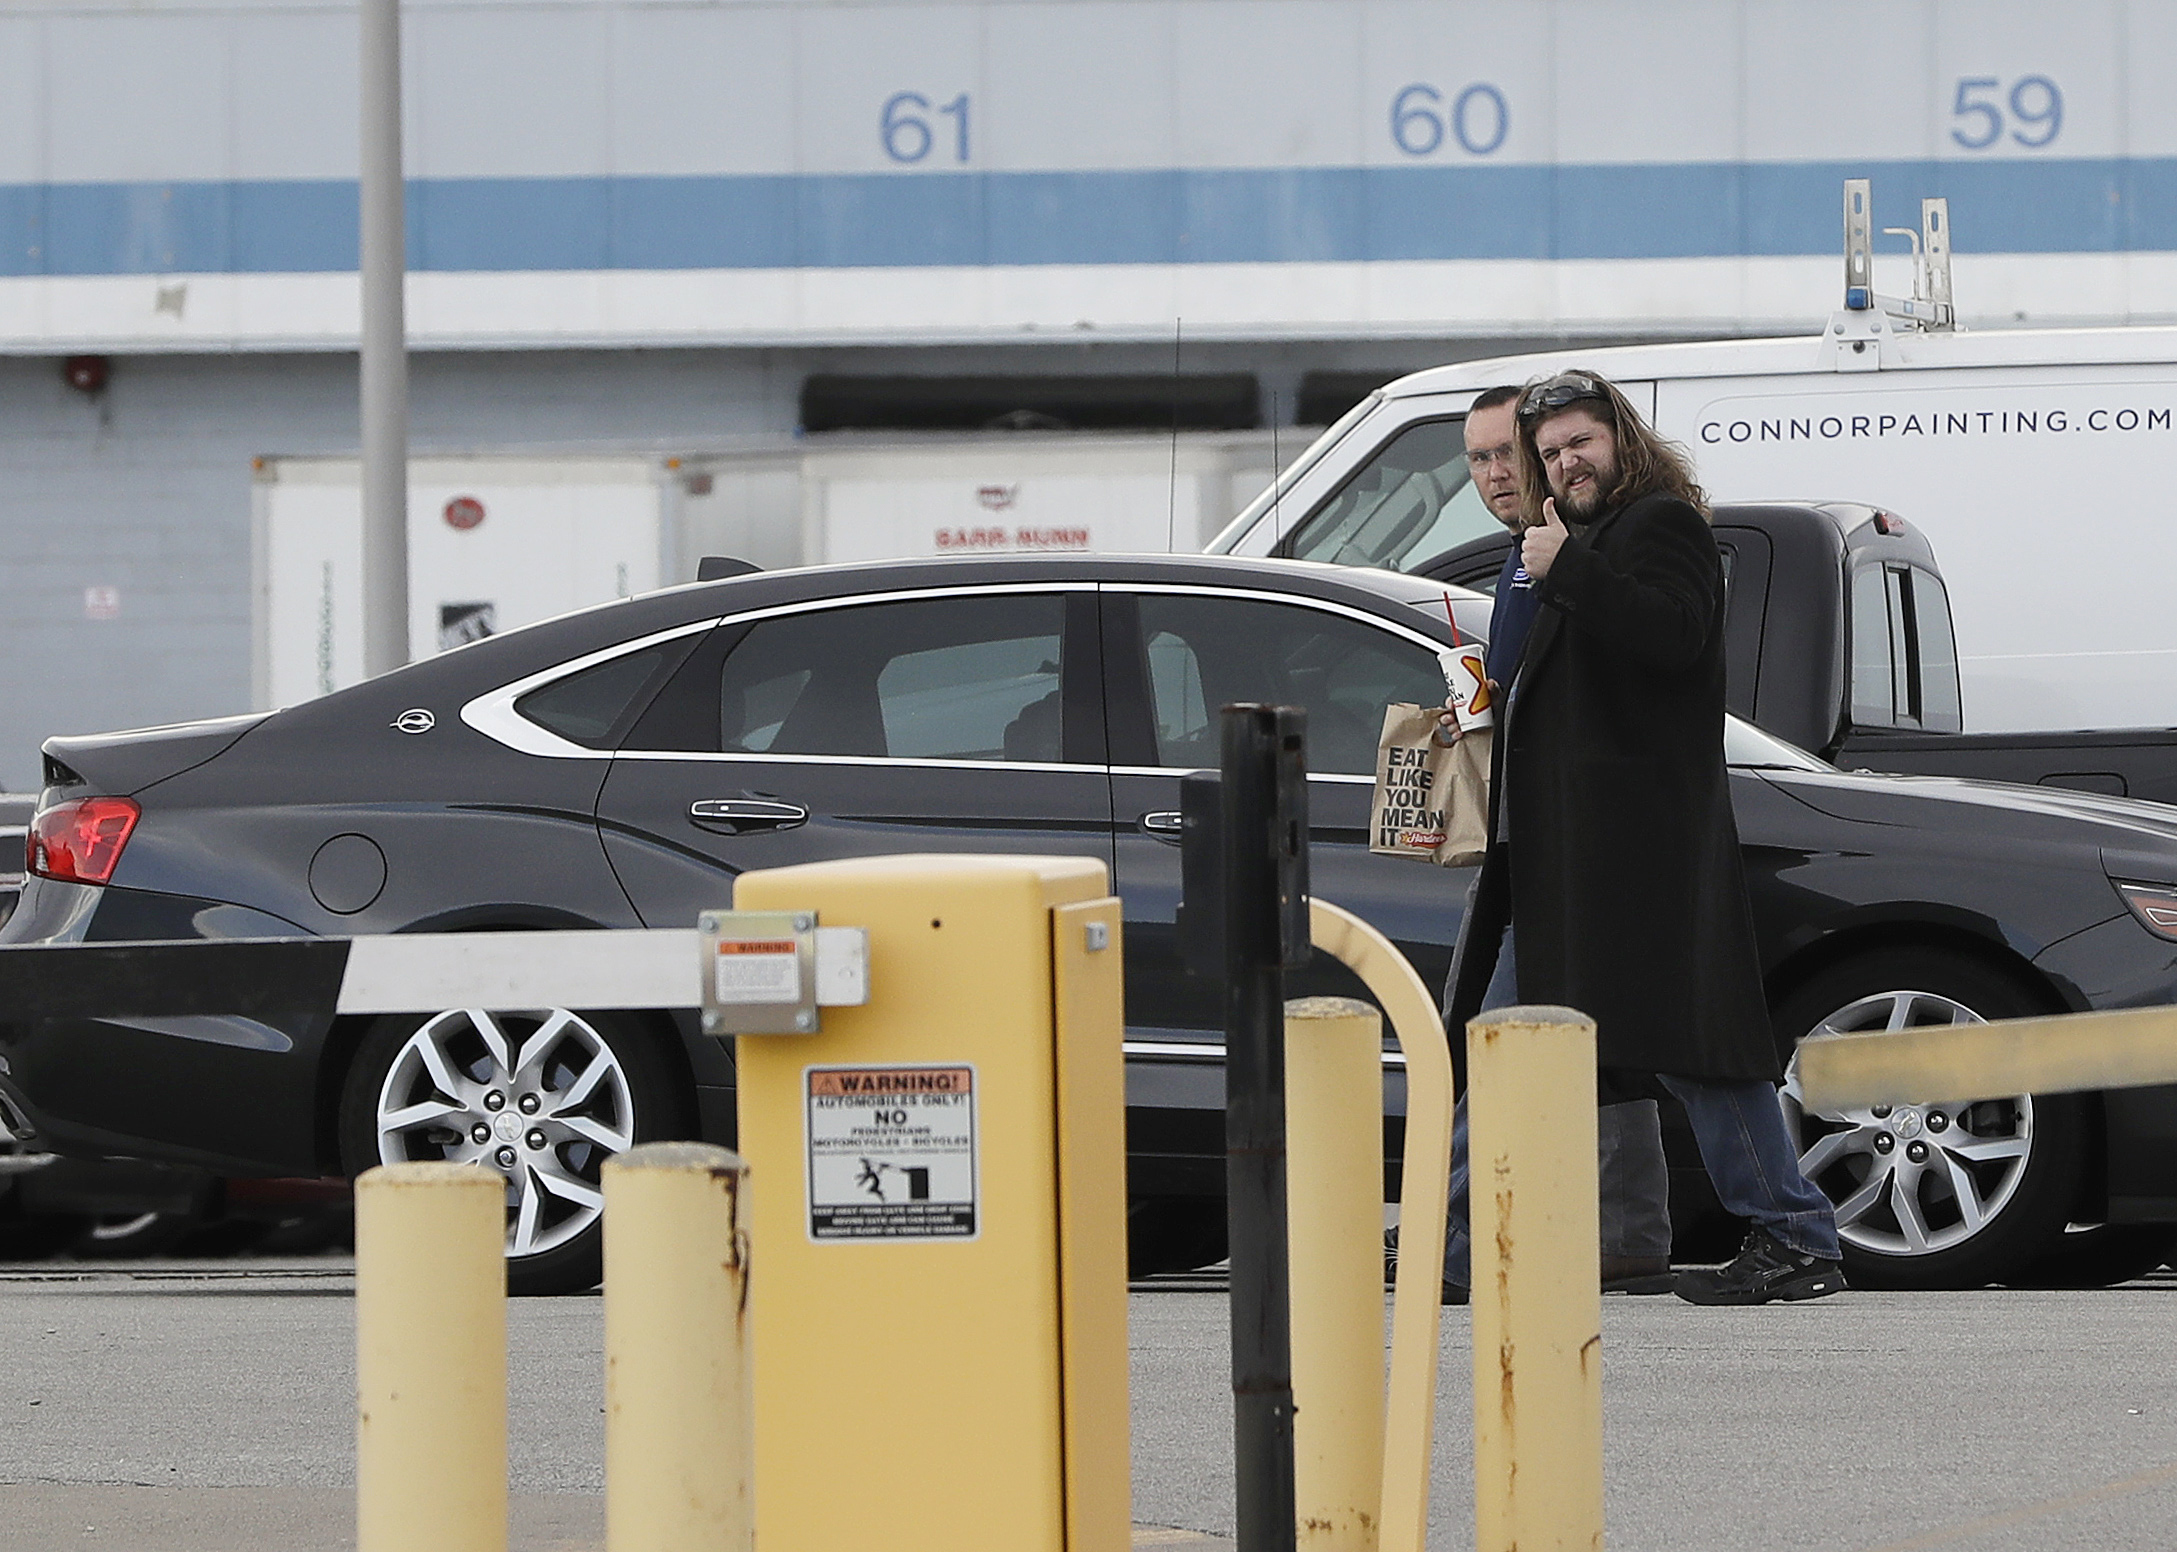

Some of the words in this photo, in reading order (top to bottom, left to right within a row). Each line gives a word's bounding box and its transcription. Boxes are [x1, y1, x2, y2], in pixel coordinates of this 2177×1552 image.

[1391, 83, 1509, 155] 60
[1951, 76, 2063, 149] 59
[880, 91, 972, 163] 61
[1700, 408, 2172, 444] CONNORPAINTING.COM
[1389, 747, 1429, 768] EAT
[1386, 767, 1434, 791] LIKE
[1385, 788, 1427, 808] YOU
[1381, 808, 1445, 829] MEAN
[1380, 828, 1399, 847] IT
[840, 1074, 958, 1092] WARNING!
[816, 1095, 918, 1109] AUTOMOBILES
[875, 1110, 908, 1126] NO
